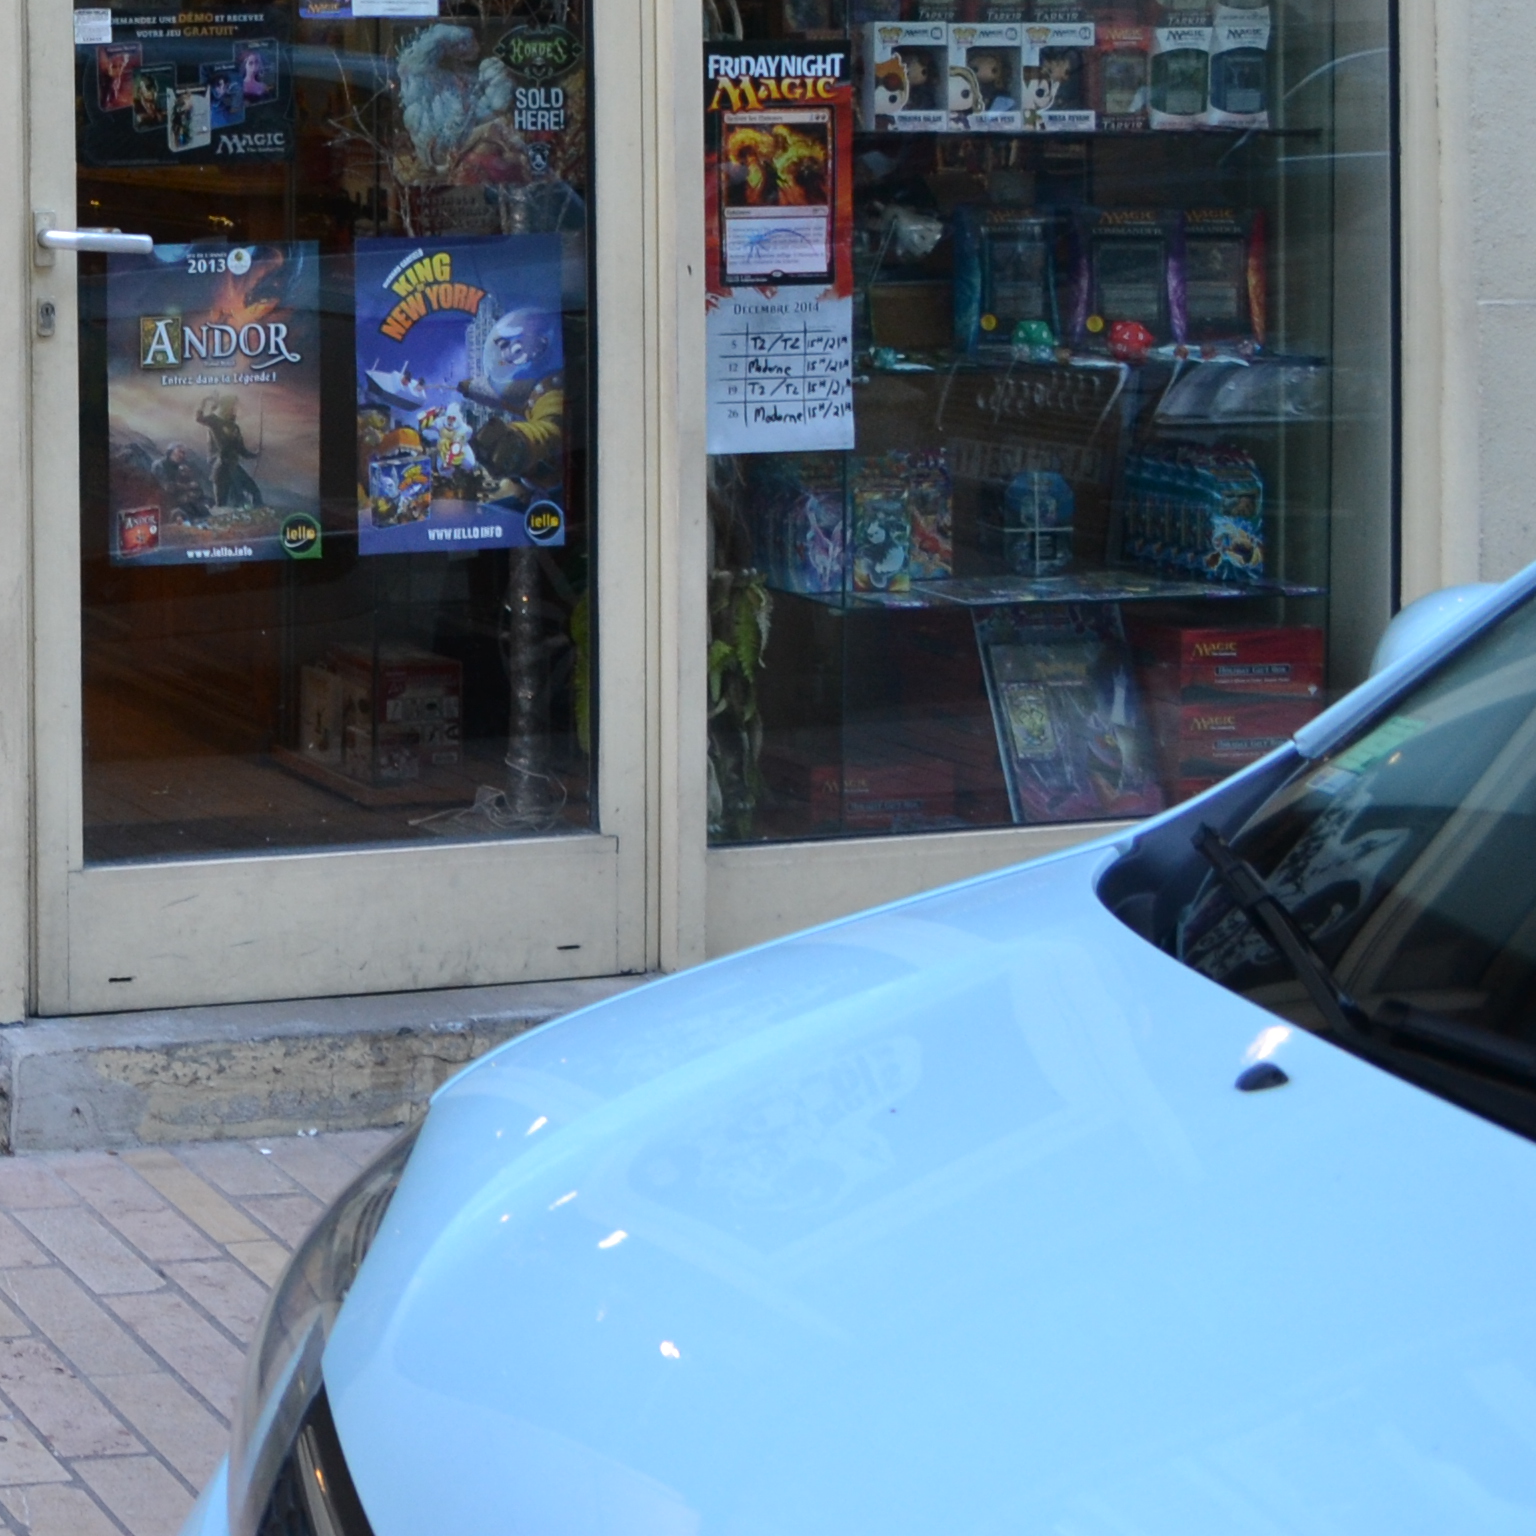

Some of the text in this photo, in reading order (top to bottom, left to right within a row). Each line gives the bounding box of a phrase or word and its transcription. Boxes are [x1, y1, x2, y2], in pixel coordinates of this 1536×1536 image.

[515, 87, 564, 109] SOLD
[708, 74, 838, 112] MAGIC
[514, 110, 565, 130] HERE!
[216, 132, 285, 154] MAGIC
[188, 259, 226, 274] 2013
[392, 252, 451, 297] KING
[380, 282, 486, 341] NEW YORK
[794, 302, 819, 312] 2014
[143, 320, 301, 369] ANDOR
[162, 374, 192, 386] Entrez
